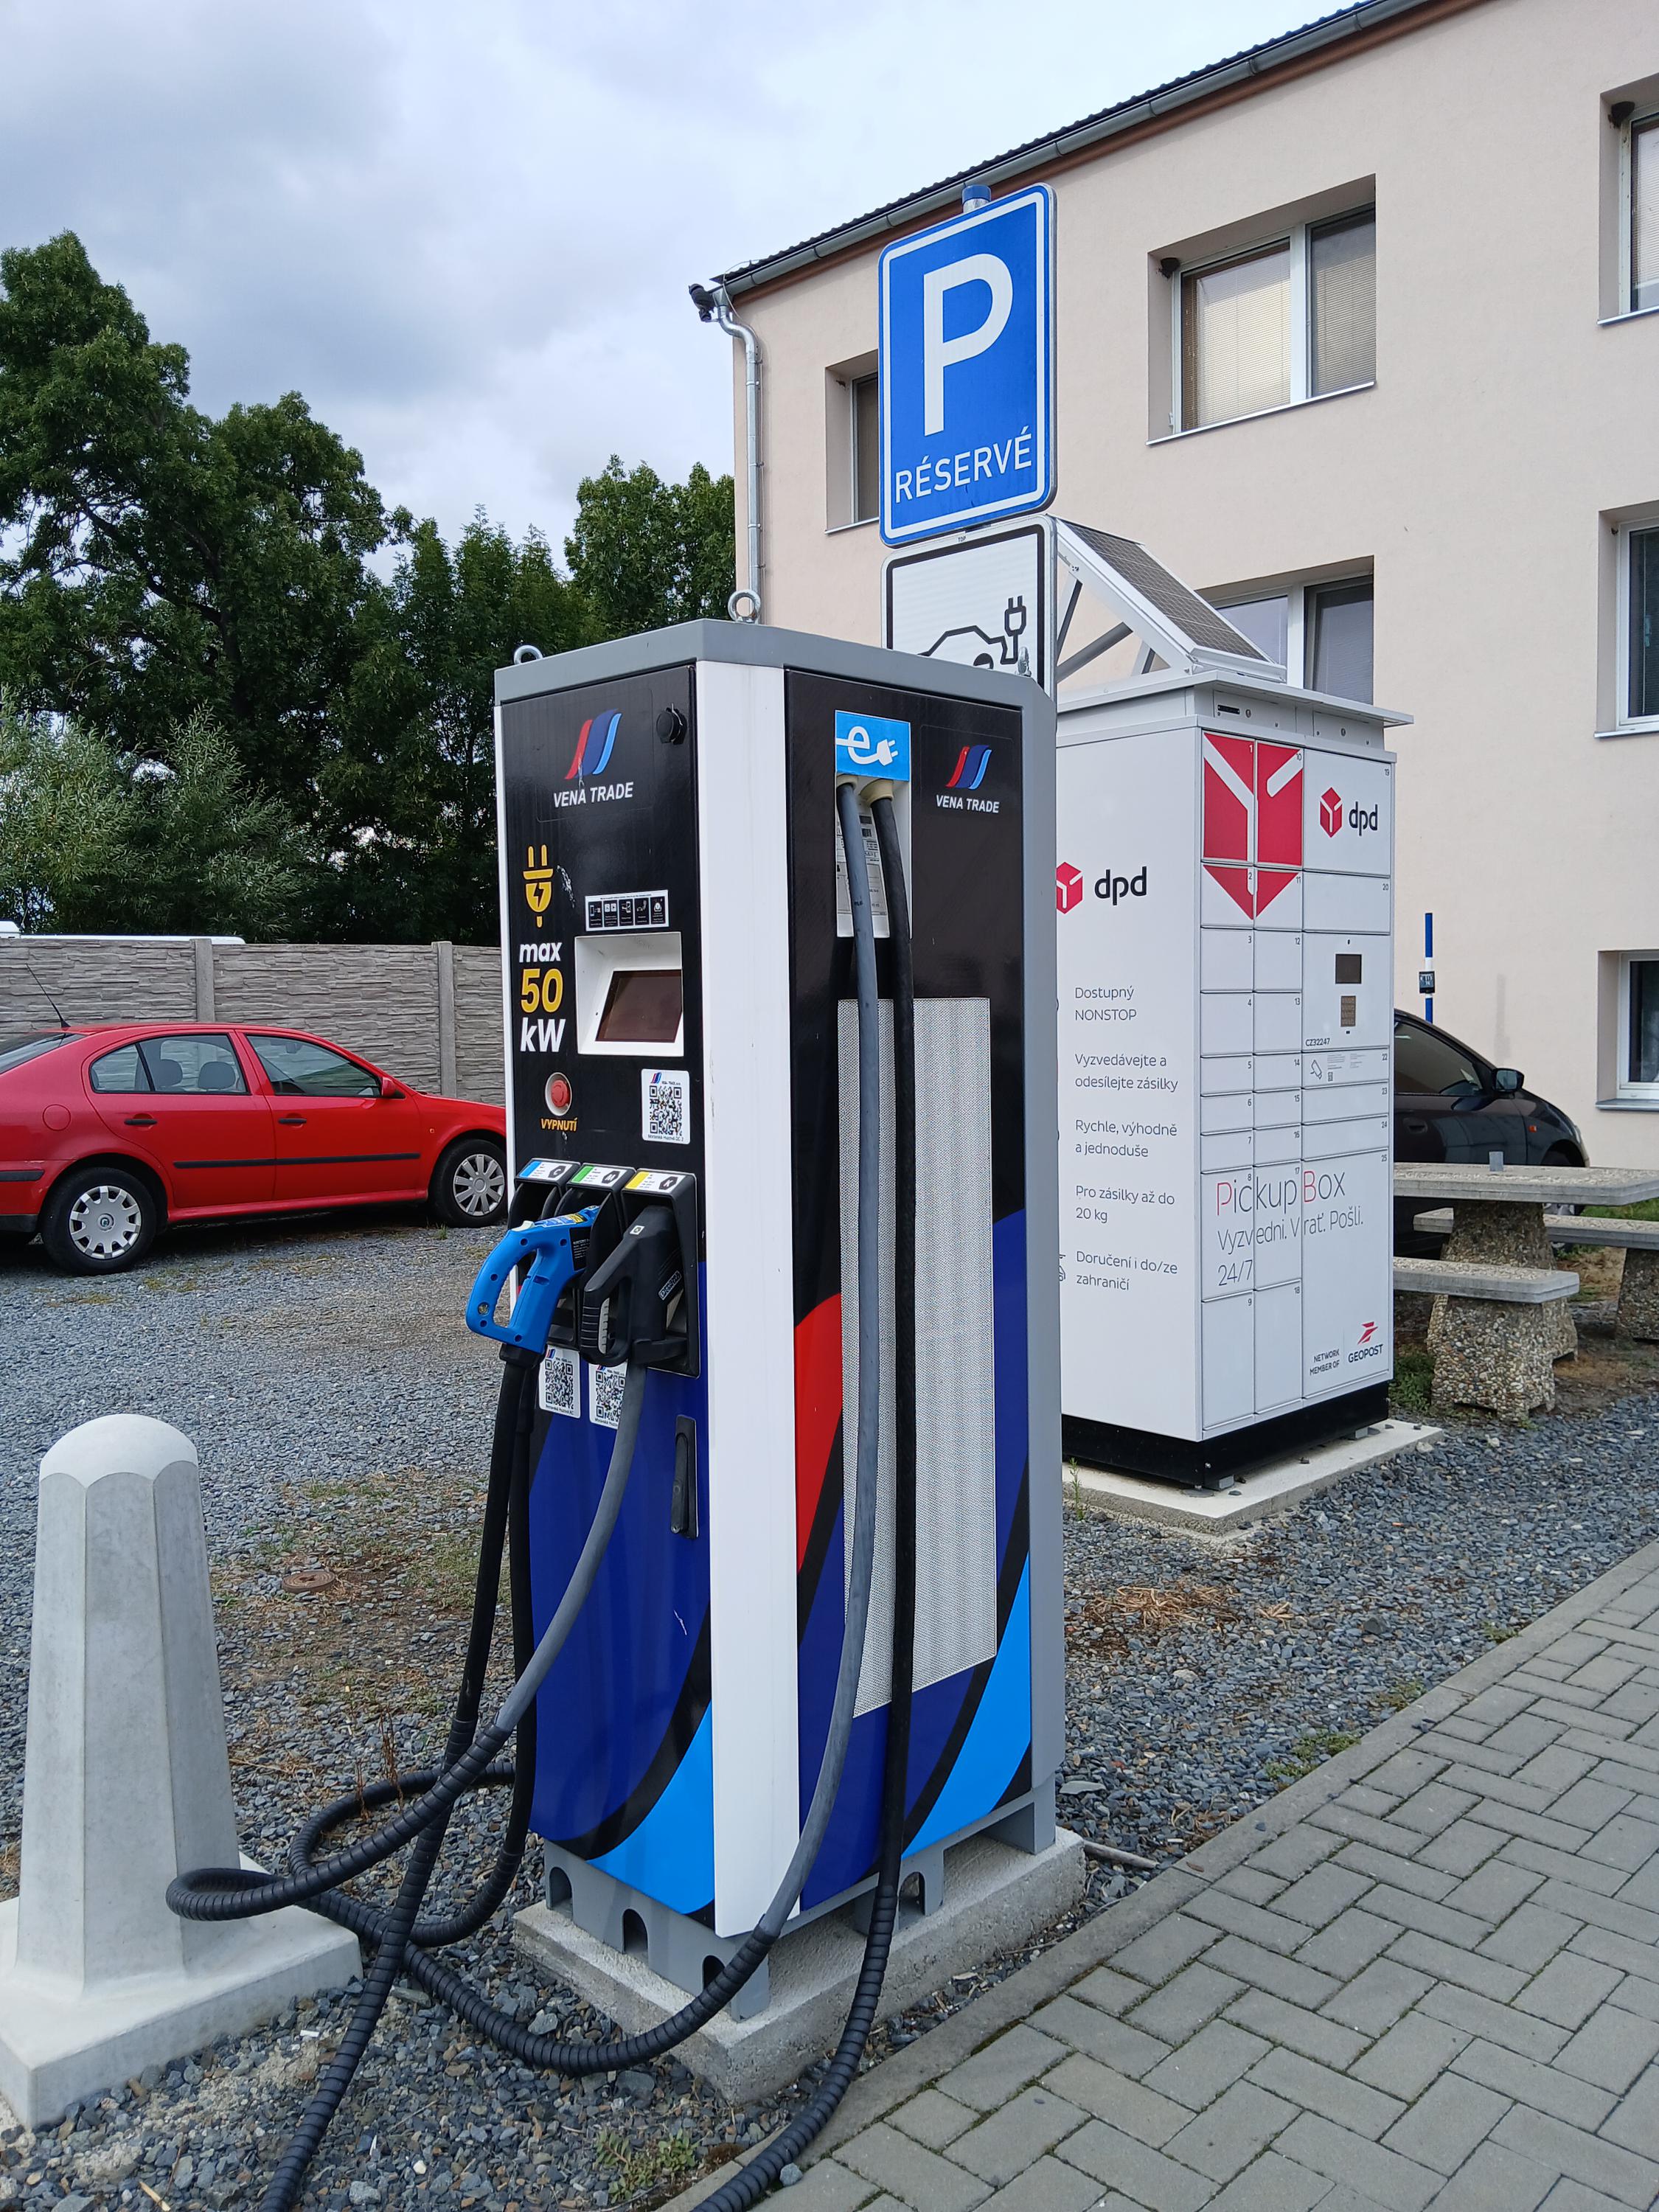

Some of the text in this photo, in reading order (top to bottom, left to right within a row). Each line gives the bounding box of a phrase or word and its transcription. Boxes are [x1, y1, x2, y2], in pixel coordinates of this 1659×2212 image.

[924, 254, 1013, 437] P
[895, 426, 1032, 503] RÉSERVÉ
[1248, 745, 1253, 754] 1
[1295, 753, 1302, 761] 10
[554, 782, 633, 808] VENA TRADE
[936, 795, 1000, 813] VENA TRADE
[1349, 801, 1378, 836] dpd
[1094, 866, 1147, 905] dpd
[1295, 876, 1301, 884] 11
[1382, 883, 1388, 891] 20
[1248, 936, 1252, 944] 3
[1295, 937, 1301, 945] 12
[519, 942, 563, 963] max
[521, 968, 563, 1013] 50
[1075, 986, 1134, 1001] Dostupný
[1248, 999, 1252, 1007] 4
[1075, 1009, 1137, 1020] NONSTOP
[520, 1017, 566, 1053] kW
[1075, 1054, 1166, 1068] Vyzvedávejte a
[1248, 1061, 1252, 1069] 5
[1075, 1075, 1178, 1093] odesílejte zásilky
[1248, 1099, 1252, 1107] 6
[540, 1117, 578, 1132] VYPNUTÍ
[1075, 1119, 1178, 1137] Rychle, výhodně
[1248, 1136, 1252, 1145] 7
[1075, 1141, 1149, 1158] a jednoduše
[1076, 1186, 1175, 1205] Pro zásilky až do
[1216, 1170, 1346, 1216] Pickup Box
[1076, 1207, 1107, 1224] 20 kg
[1217, 1220, 1287, 1255] Vyzvedni.
[1329, 1206, 1363, 1229] Pošli.
[1077, 1251, 1178, 1274] Doručení i do/ze
[1218, 1259, 1253, 1287] 24/7
[1077, 1274, 1130, 1290] zahraničí
[1248, 1298, 1252, 1307] 9
[1313, 1349, 1340, 1363] NETWORK
[1348, 1343, 1383, 1363] GEOPOST
[1310, 1360, 1340, 1376] MEMBER OF
